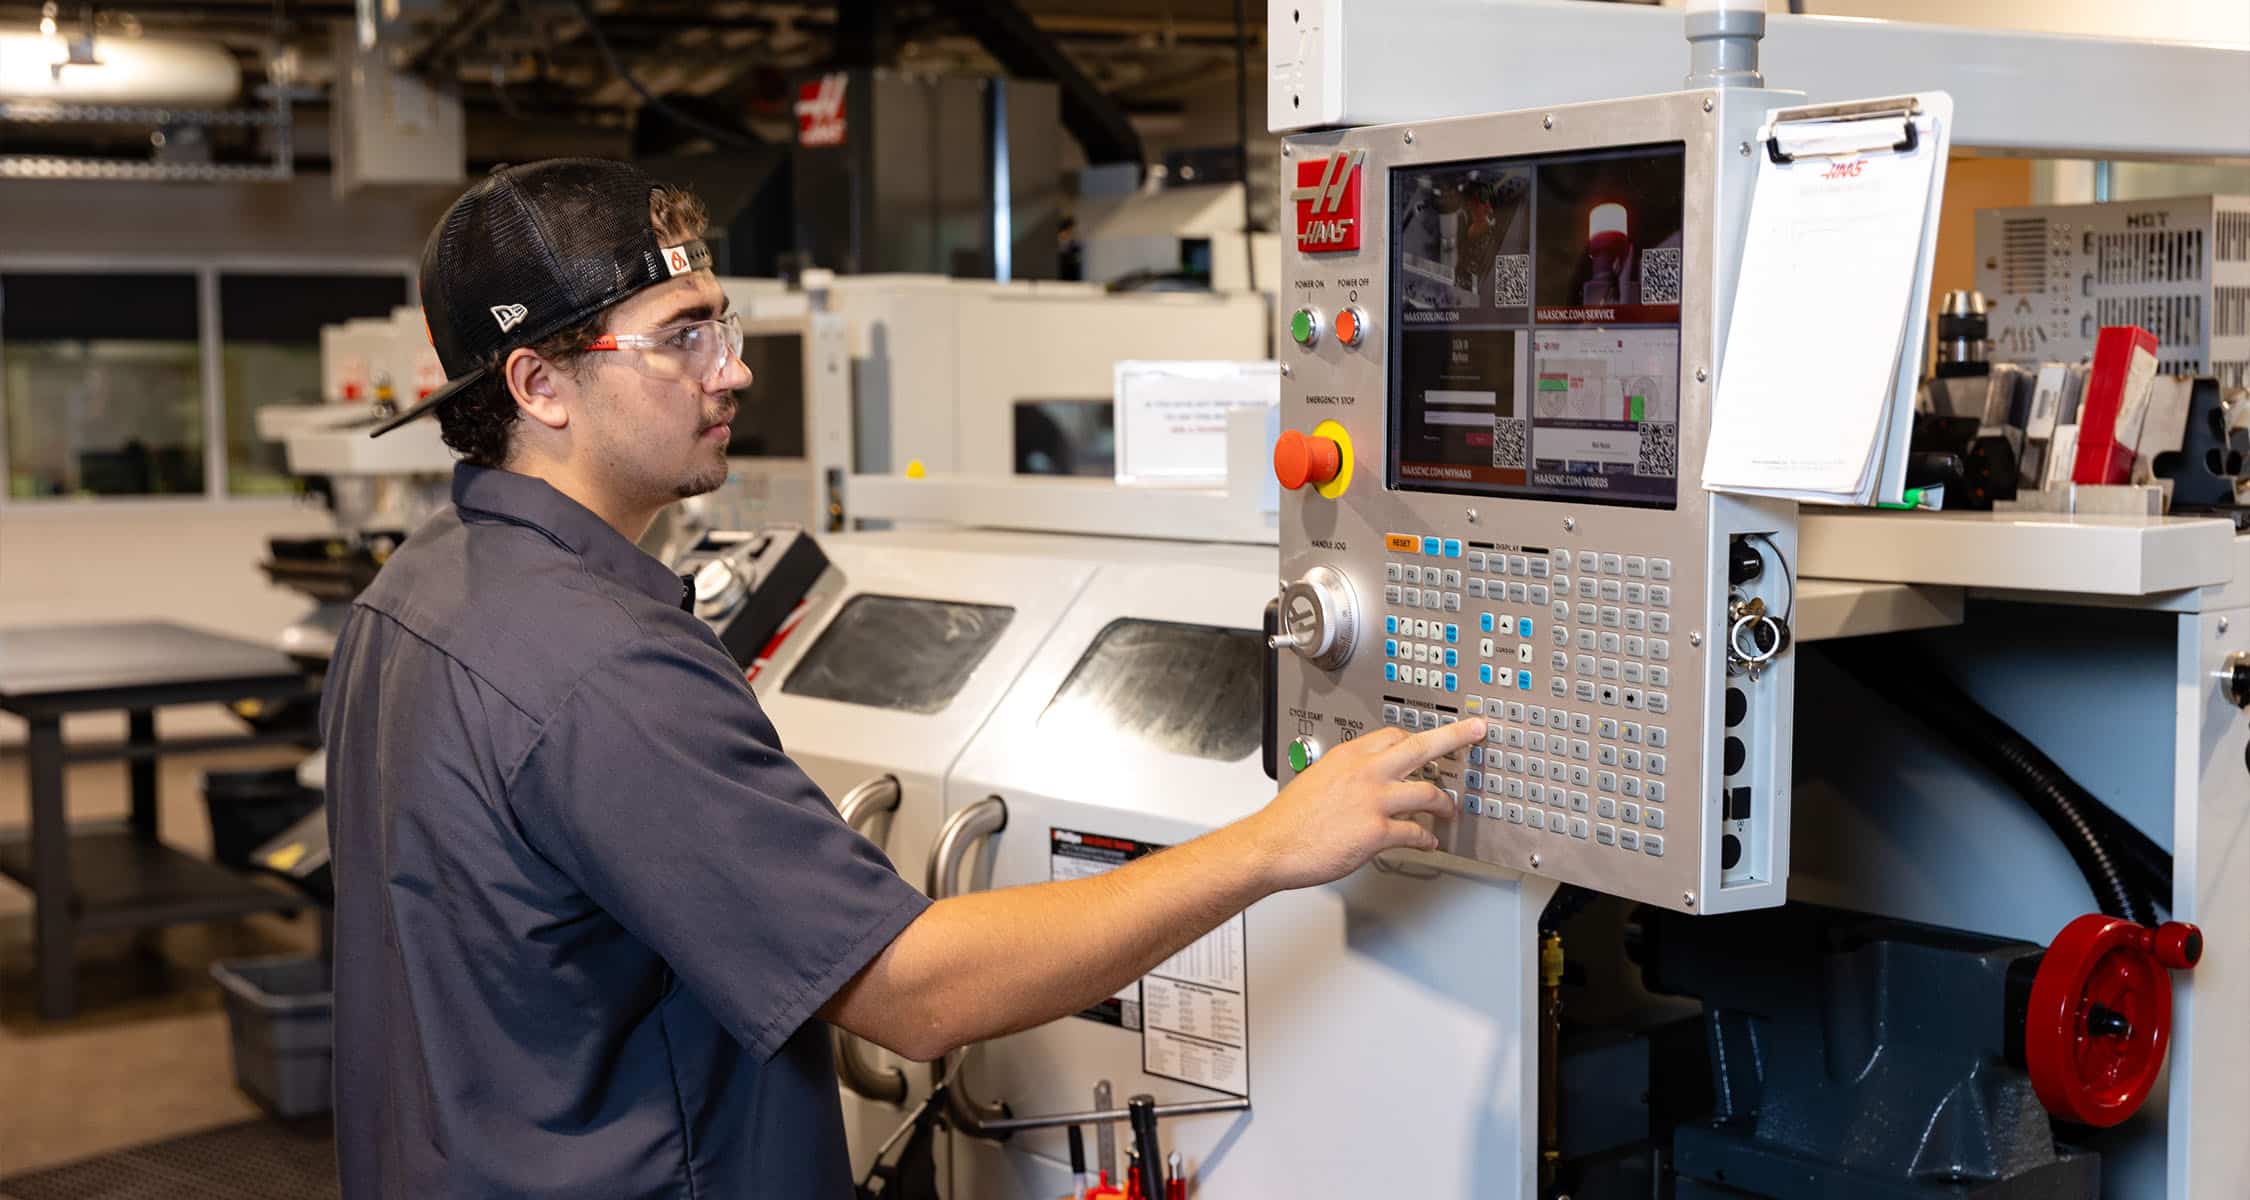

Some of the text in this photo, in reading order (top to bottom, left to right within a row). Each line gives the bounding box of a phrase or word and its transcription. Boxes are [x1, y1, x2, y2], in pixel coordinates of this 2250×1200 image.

[1821, 160, 1868, 180] HAAS
[1296, 218, 1353, 245] HAAS
[1295, 279, 1325, 288] POWER ON
[1337, 277, 1369, 288] POWER OFF
[1537, 309, 1615, 321] HAASCNC.COM/SERVICE
[1306, 395, 1355, 406] EMERGENCY STOP
[1534, 473, 1608, 488] HAASCNC.COM/VIDEOS
[1334, 541, 1346, 551] JOG
[1392, 538, 1411, 547] RESET
[1495, 543, 1520, 552] DISPLAY
[1495, 647, 1515, 655] CURSOR
[1289, 708, 1323, 721] CYCLE START
[1334, 717, 1363, 730] FEED HOLD
